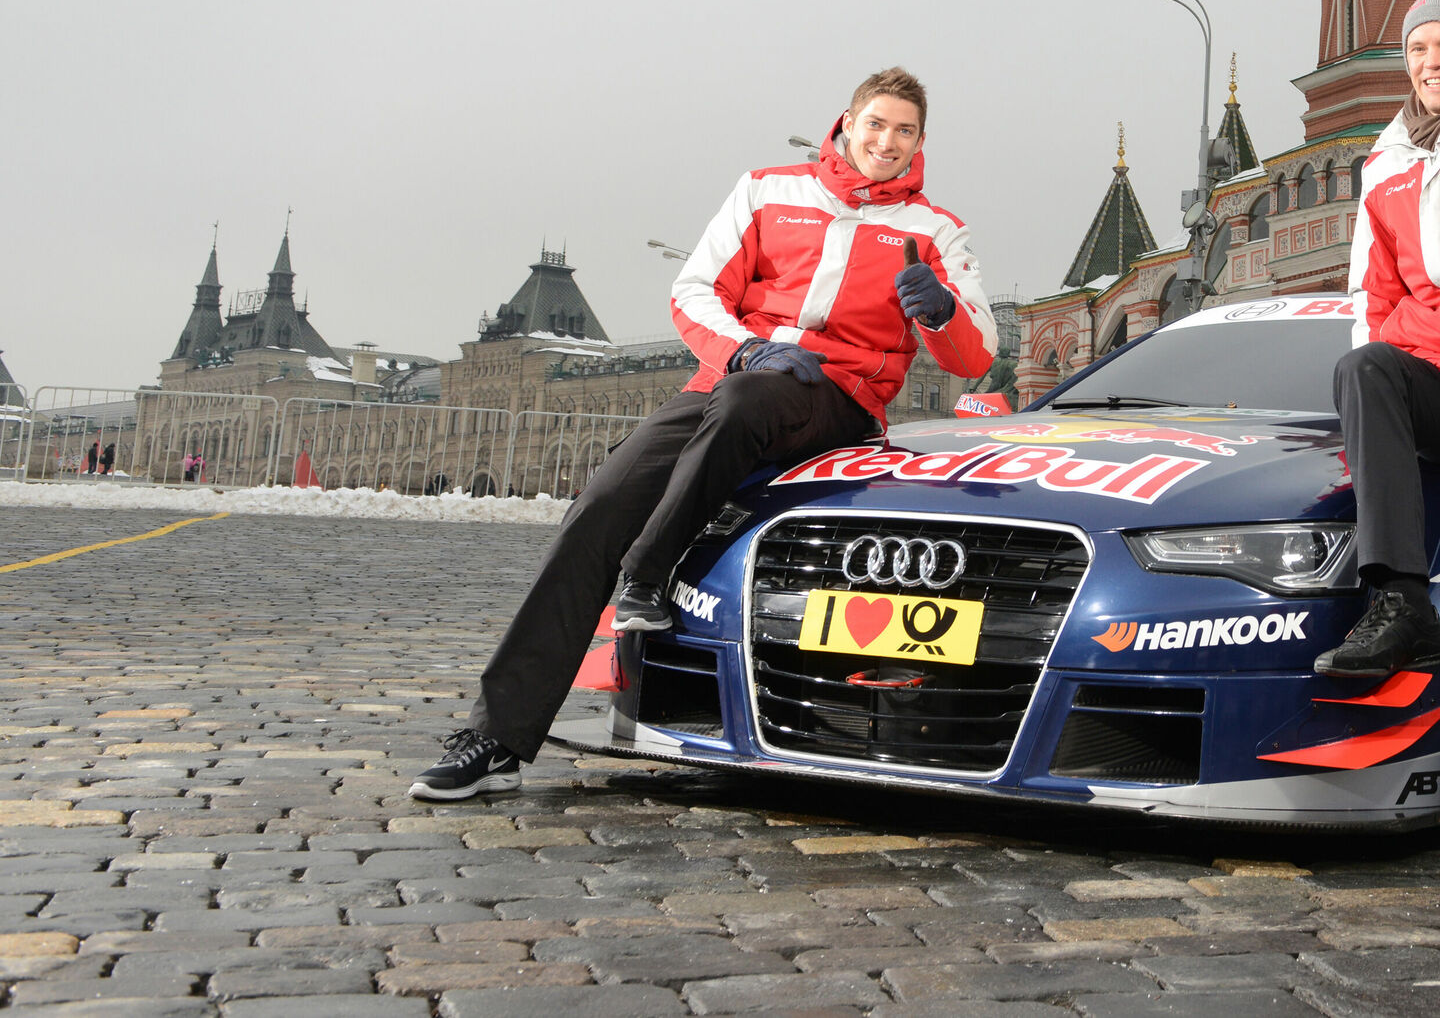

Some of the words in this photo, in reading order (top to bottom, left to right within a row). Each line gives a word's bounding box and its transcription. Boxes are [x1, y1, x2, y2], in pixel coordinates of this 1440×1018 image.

[803, 217, 822, 225] Sport
[768, 444, 1010, 486] Red
[957, 444, 1212, 505] Bull
